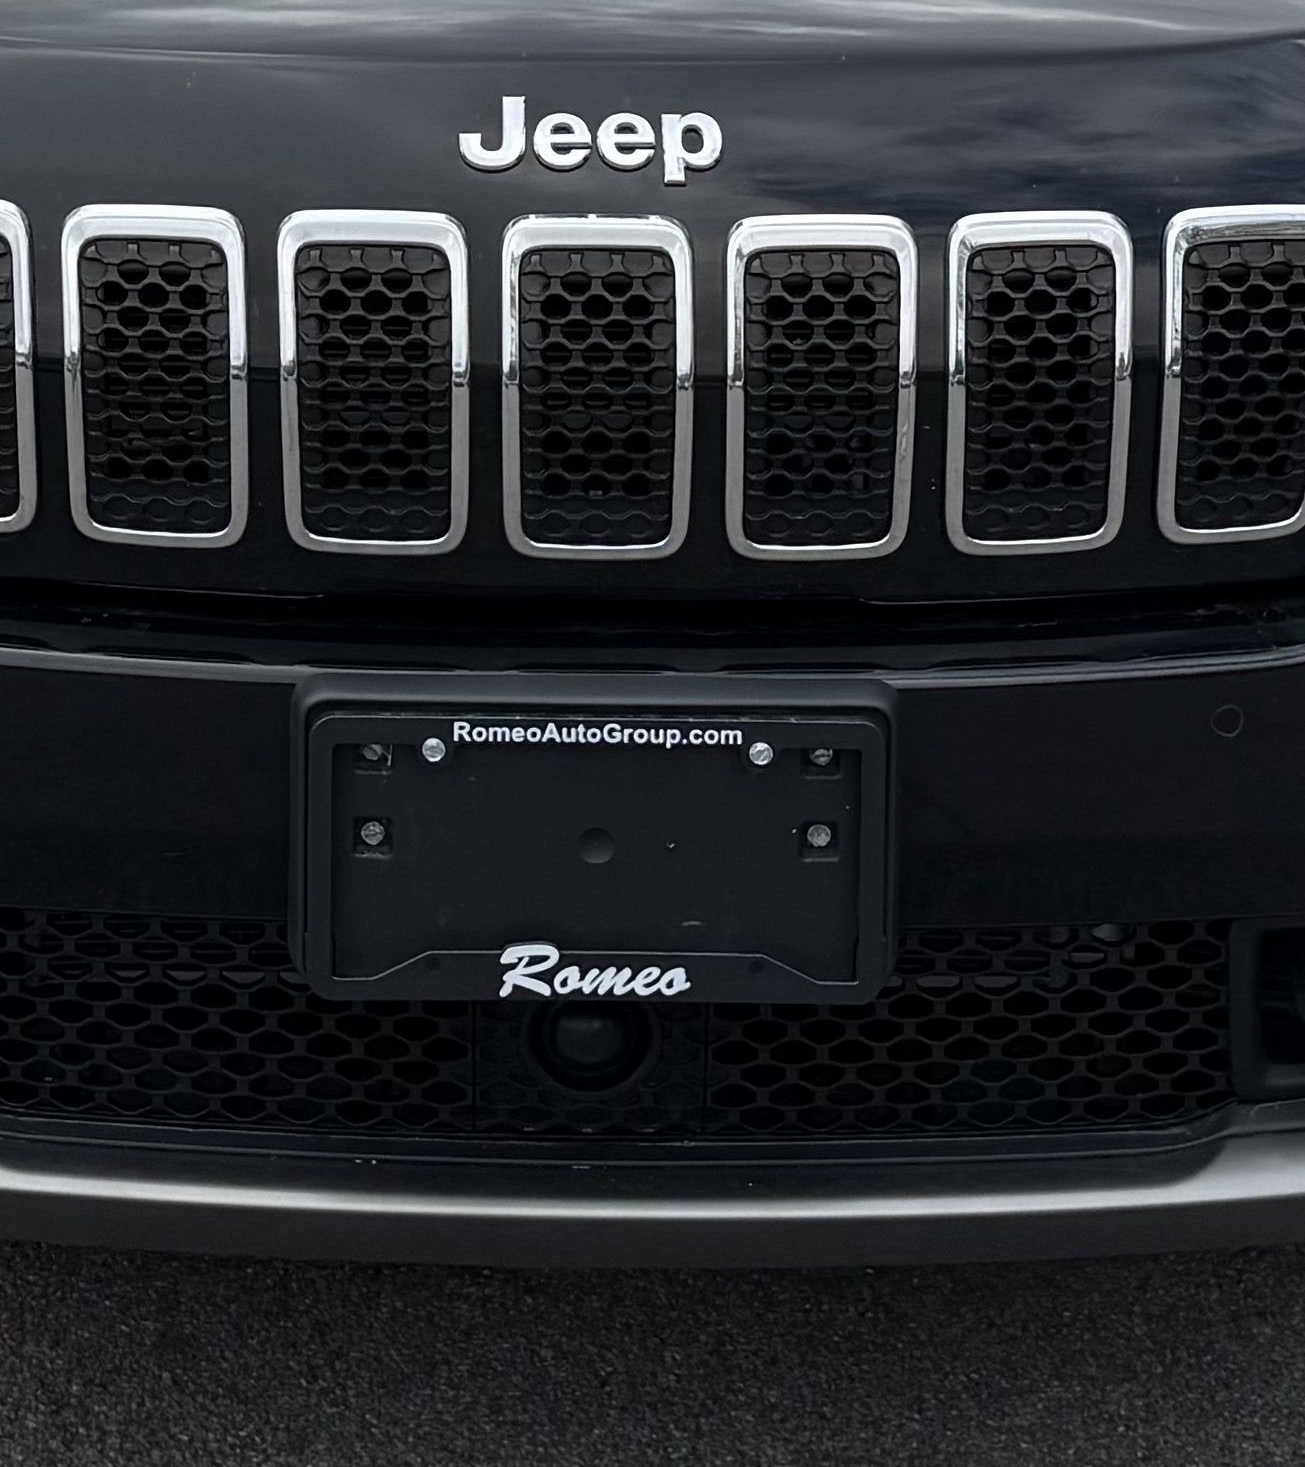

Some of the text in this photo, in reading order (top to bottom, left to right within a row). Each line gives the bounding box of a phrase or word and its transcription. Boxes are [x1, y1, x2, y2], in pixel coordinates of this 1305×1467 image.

[458, 95, 723, 186] Jeep
[452, 721, 743, 749] RomeoAutoGroup.com
[499, 942, 692, 998] Romeo
